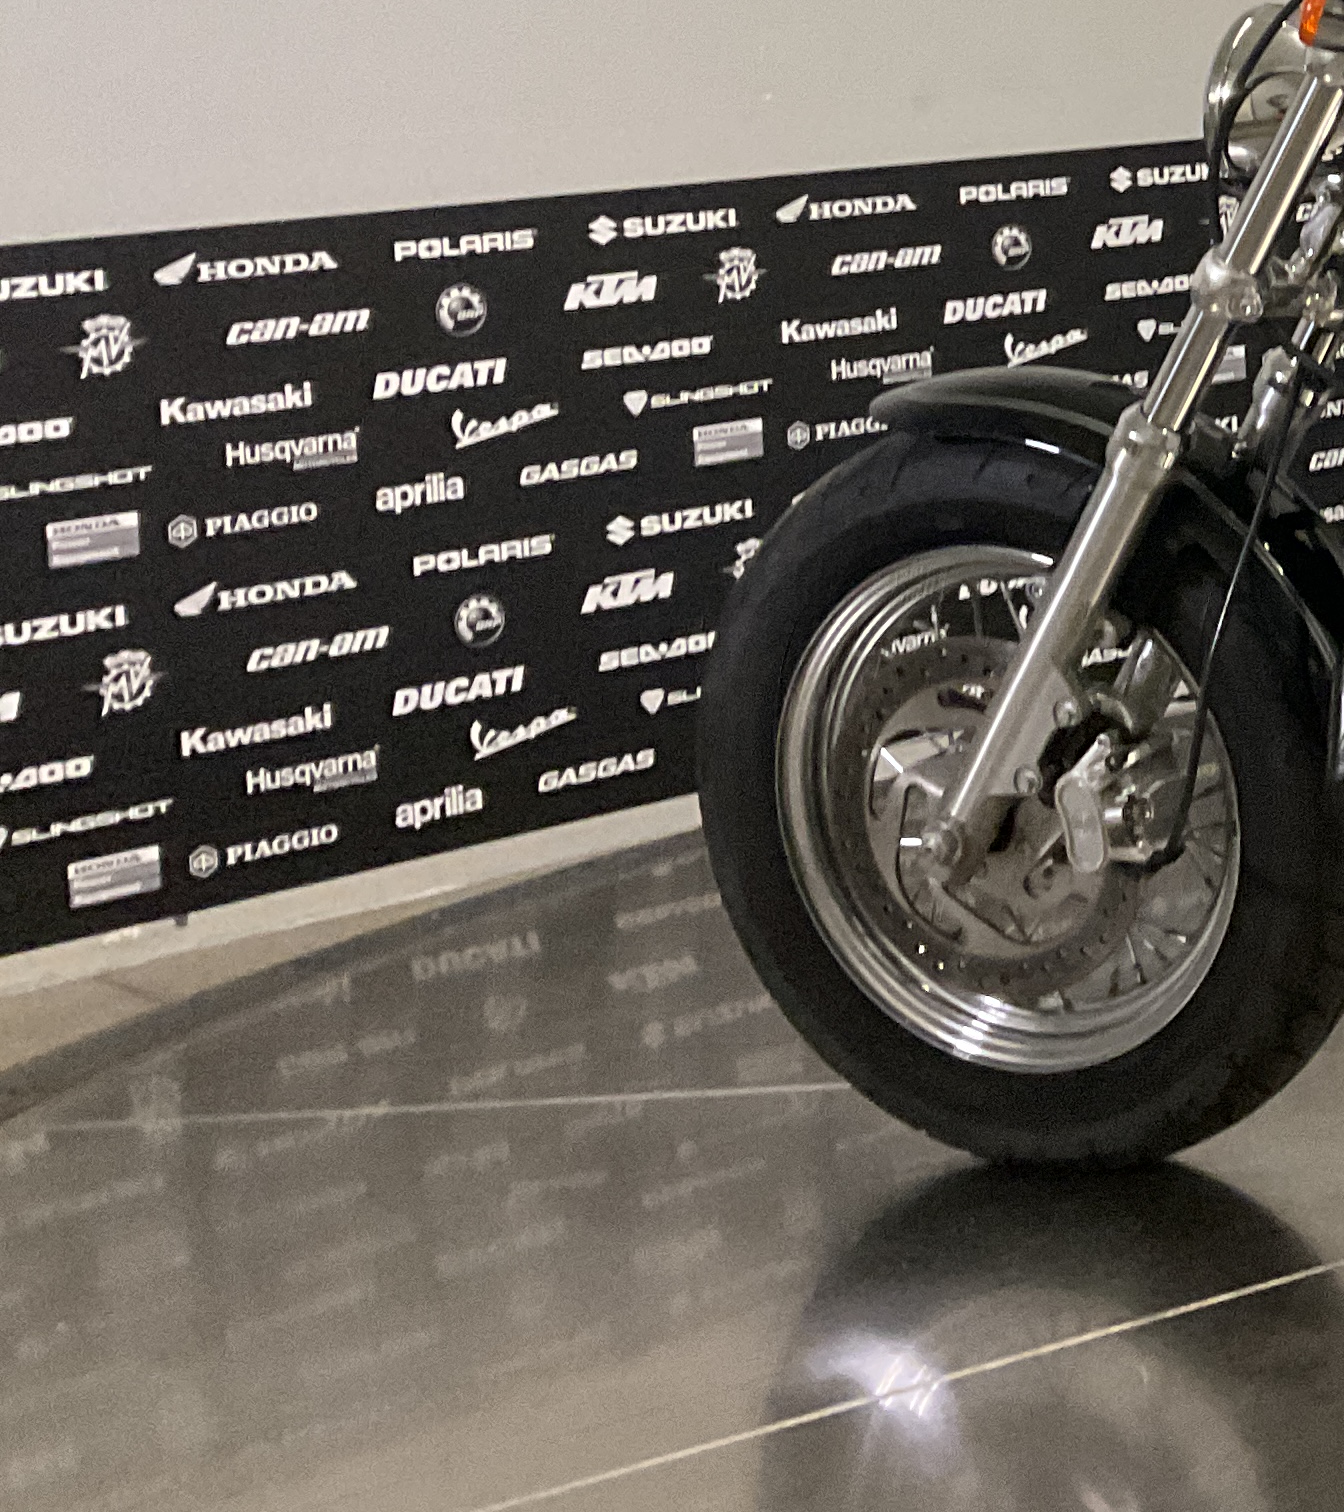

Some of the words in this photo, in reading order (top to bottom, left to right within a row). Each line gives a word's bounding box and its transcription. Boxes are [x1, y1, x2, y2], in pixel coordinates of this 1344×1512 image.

[960, 177, 1067, 204] POLARIS
[1137, 163, 1209, 186] SUZU
[623, 208, 736, 237] SUZUKI
[810, 194, 916, 220] HONDA
[394, 229, 534, 261] POLARIS
[1091, 215, 1163, 249] KTM
[197, 251, 337, 282] HONDA
[832, 244, 941, 275] can-am
[0, 270, 108, 301] ZUKI
[564, 271, 657, 310] KTM
[781, 307, 897, 343] Kawasaki
[944, 289, 1046, 324] DUCATI
[226, 309, 370, 345] can-am
[831, 346, 933, 380] Husqvarna
[1004, 329, 1087, 369] Vespa
[373, 358, 506, 399] DUCATI
[160, 382, 312, 425] Kawasaki
[452, 404, 558, 449] Vespa
[816, 416, 887, 441] PIAGG
[226, 428, 358, 467] Husqvarna
[520, 450, 637, 486] GASGAS
[376, 472, 464, 514] aprilia
[205, 503, 317, 536] PIAGGIO
[641, 499, 753, 536] SUZUKI
[413, 535, 555, 576] POLARIS
[218, 571, 357, 610] HONDA
[581, 569, 674, 614] KTM
[0, 605, 126, 645] UZUKI
[247, 626, 389, 672] can-am
[393, 666, 524, 716] DUCATI
[181, 704, 332, 758] Kawasaki
[470, 708, 576, 760] Vespa
[246, 746, 378, 794] Husqvarna
[538, 749, 654, 792] GASGAS
[396, 785, 482, 829] aprilia
[227, 824, 338, 865] PIAGGIO
